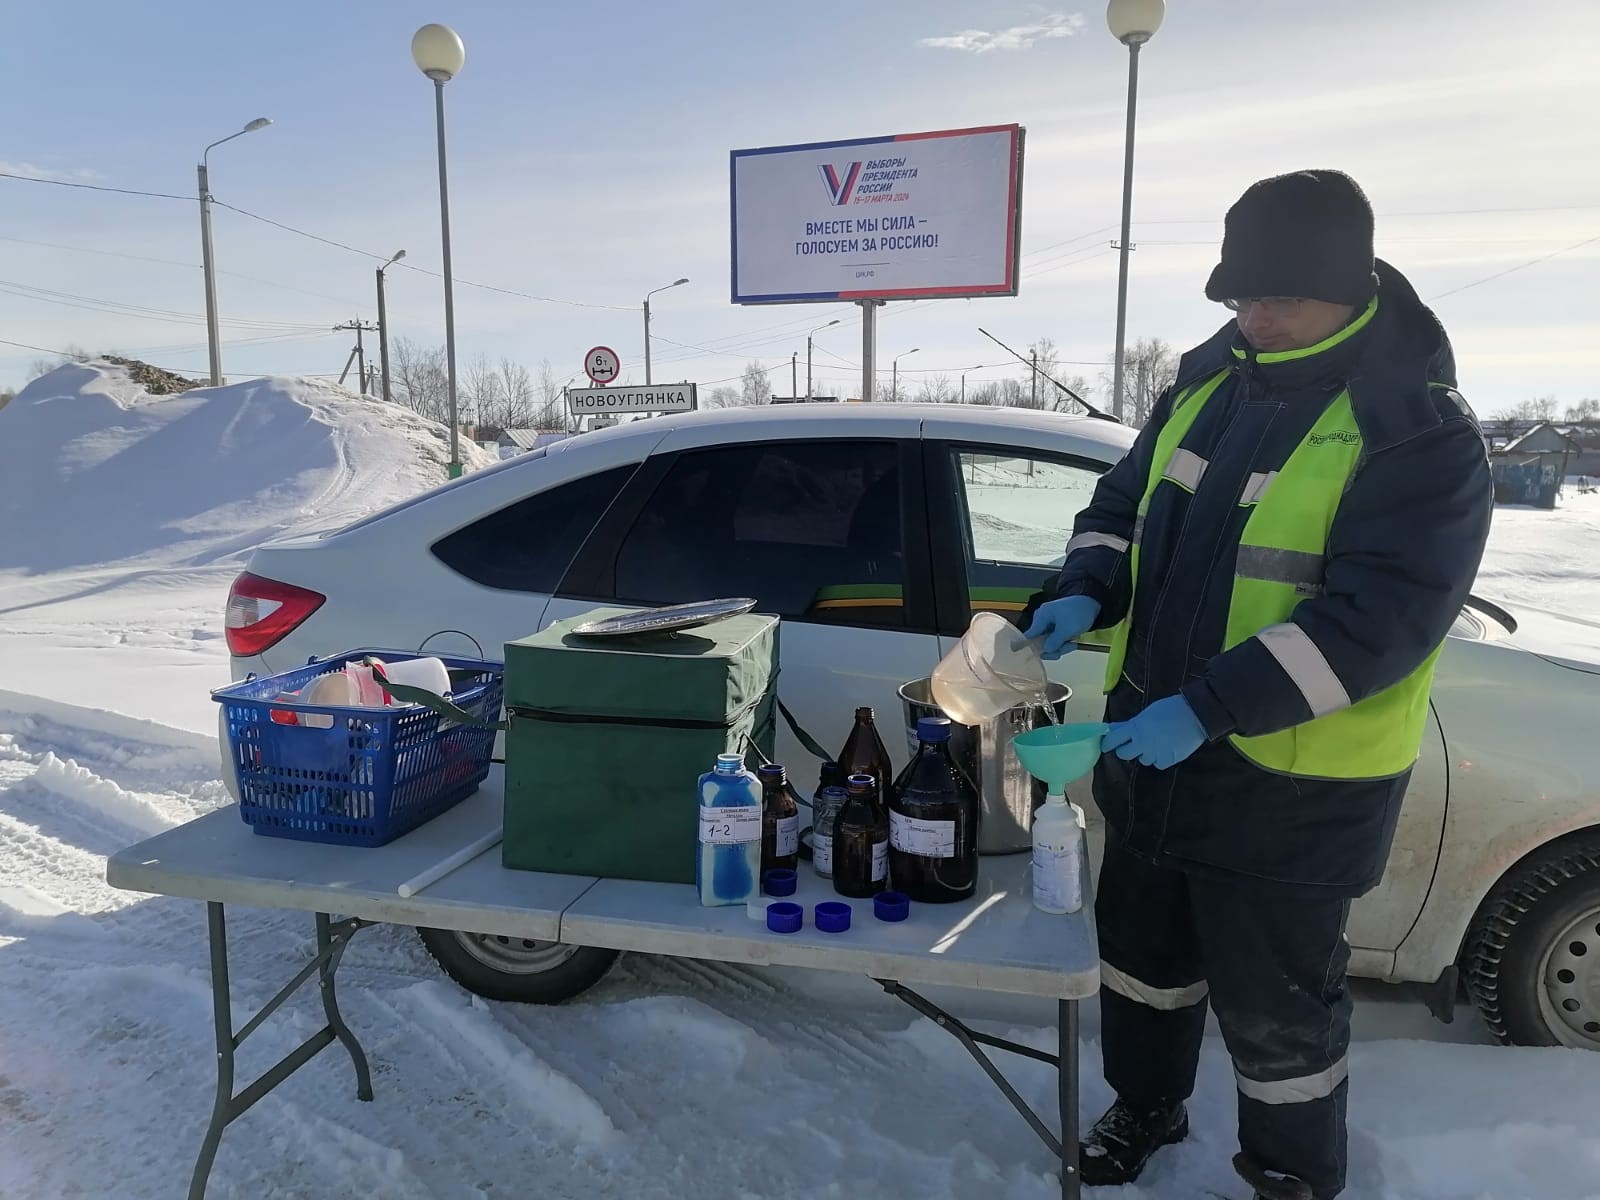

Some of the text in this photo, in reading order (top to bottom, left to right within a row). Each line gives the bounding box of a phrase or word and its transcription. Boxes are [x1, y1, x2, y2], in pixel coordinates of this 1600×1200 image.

[866, 157, 907, 170] ВЫБОРЫ
[861, 168, 918, 182] ПРЕЗИДЕНТА
[857, 182, 893, 194] РОССИИ
[871, 194, 893, 203] МАРТА
[893, 192, 910, 202] 2024
[806, 220, 853, 235] ВМЕСТЕ
[856, 218, 878, 233] МЫ
[882, 215, 915, 231] СИЛА
[795, 234, 939, 255] ГОЛОСУЕМ ЗА РОССИЮ!
[575, 391, 686, 408] НОВОУГЛЯНКА
[708, 824, 731, 837] 1-2
